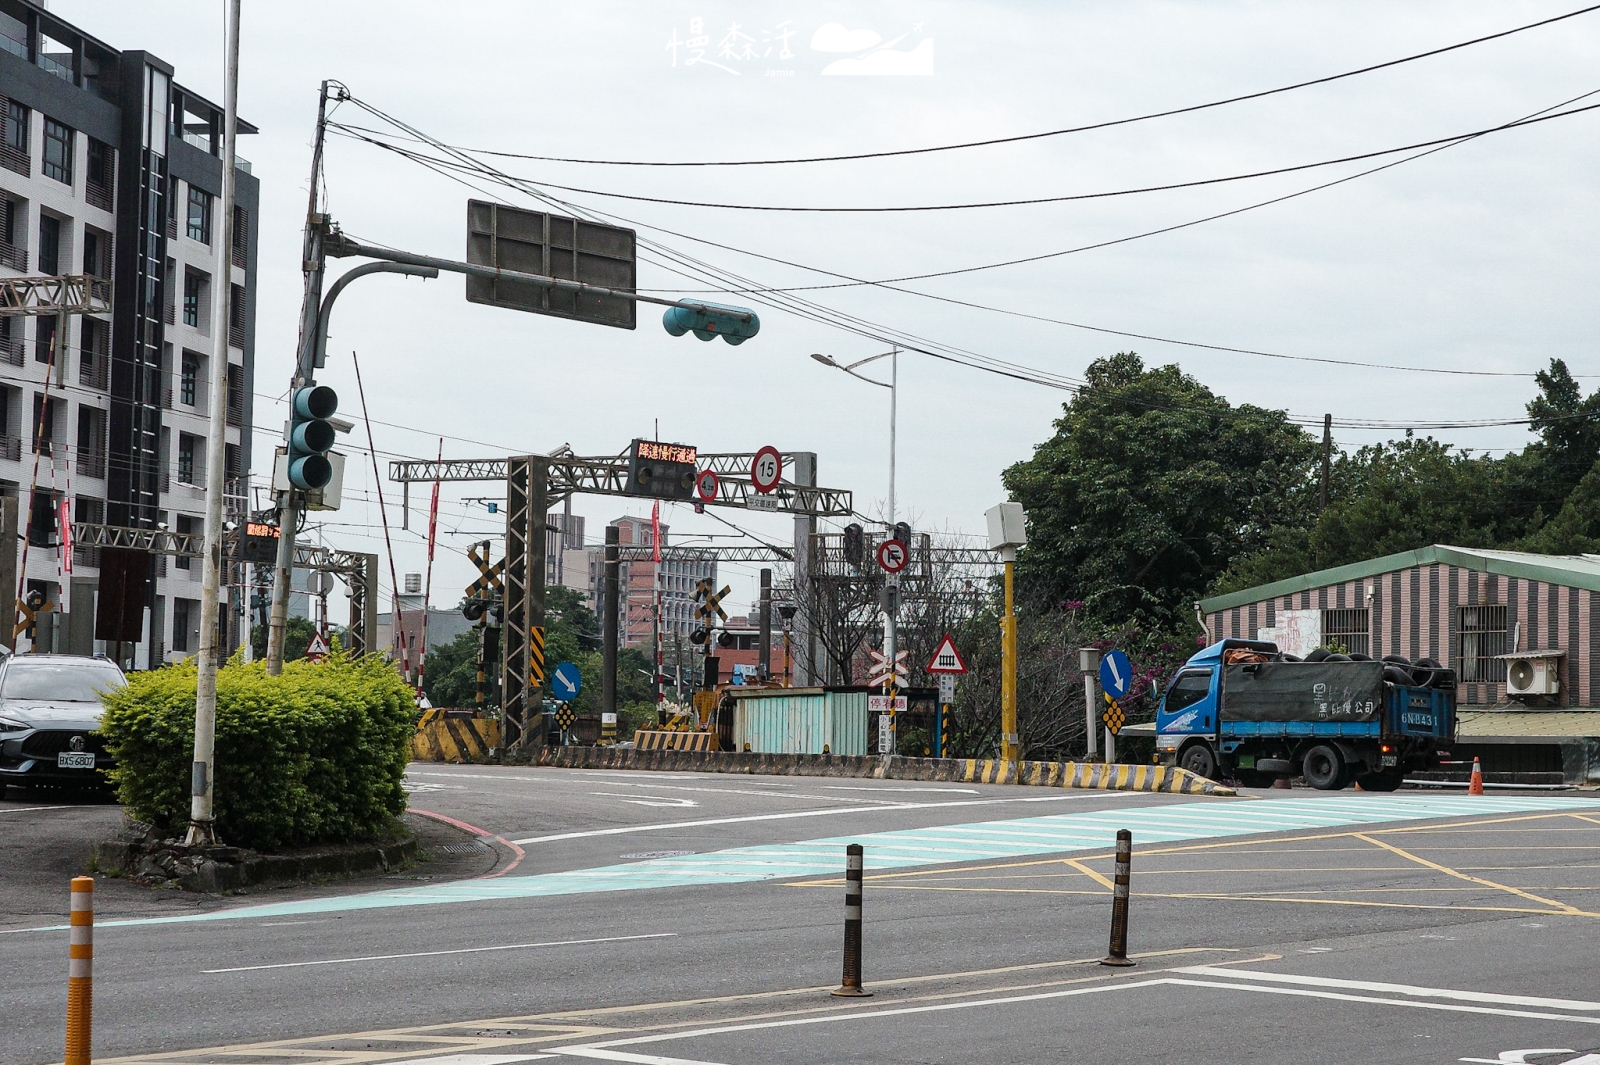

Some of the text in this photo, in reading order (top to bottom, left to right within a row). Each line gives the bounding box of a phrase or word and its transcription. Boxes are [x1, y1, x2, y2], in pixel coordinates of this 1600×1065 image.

[638, 442, 696, 464] 降速慢行通過
[759, 461, 774, 478] 15
[870, 697, 906, 709] 停看聽
